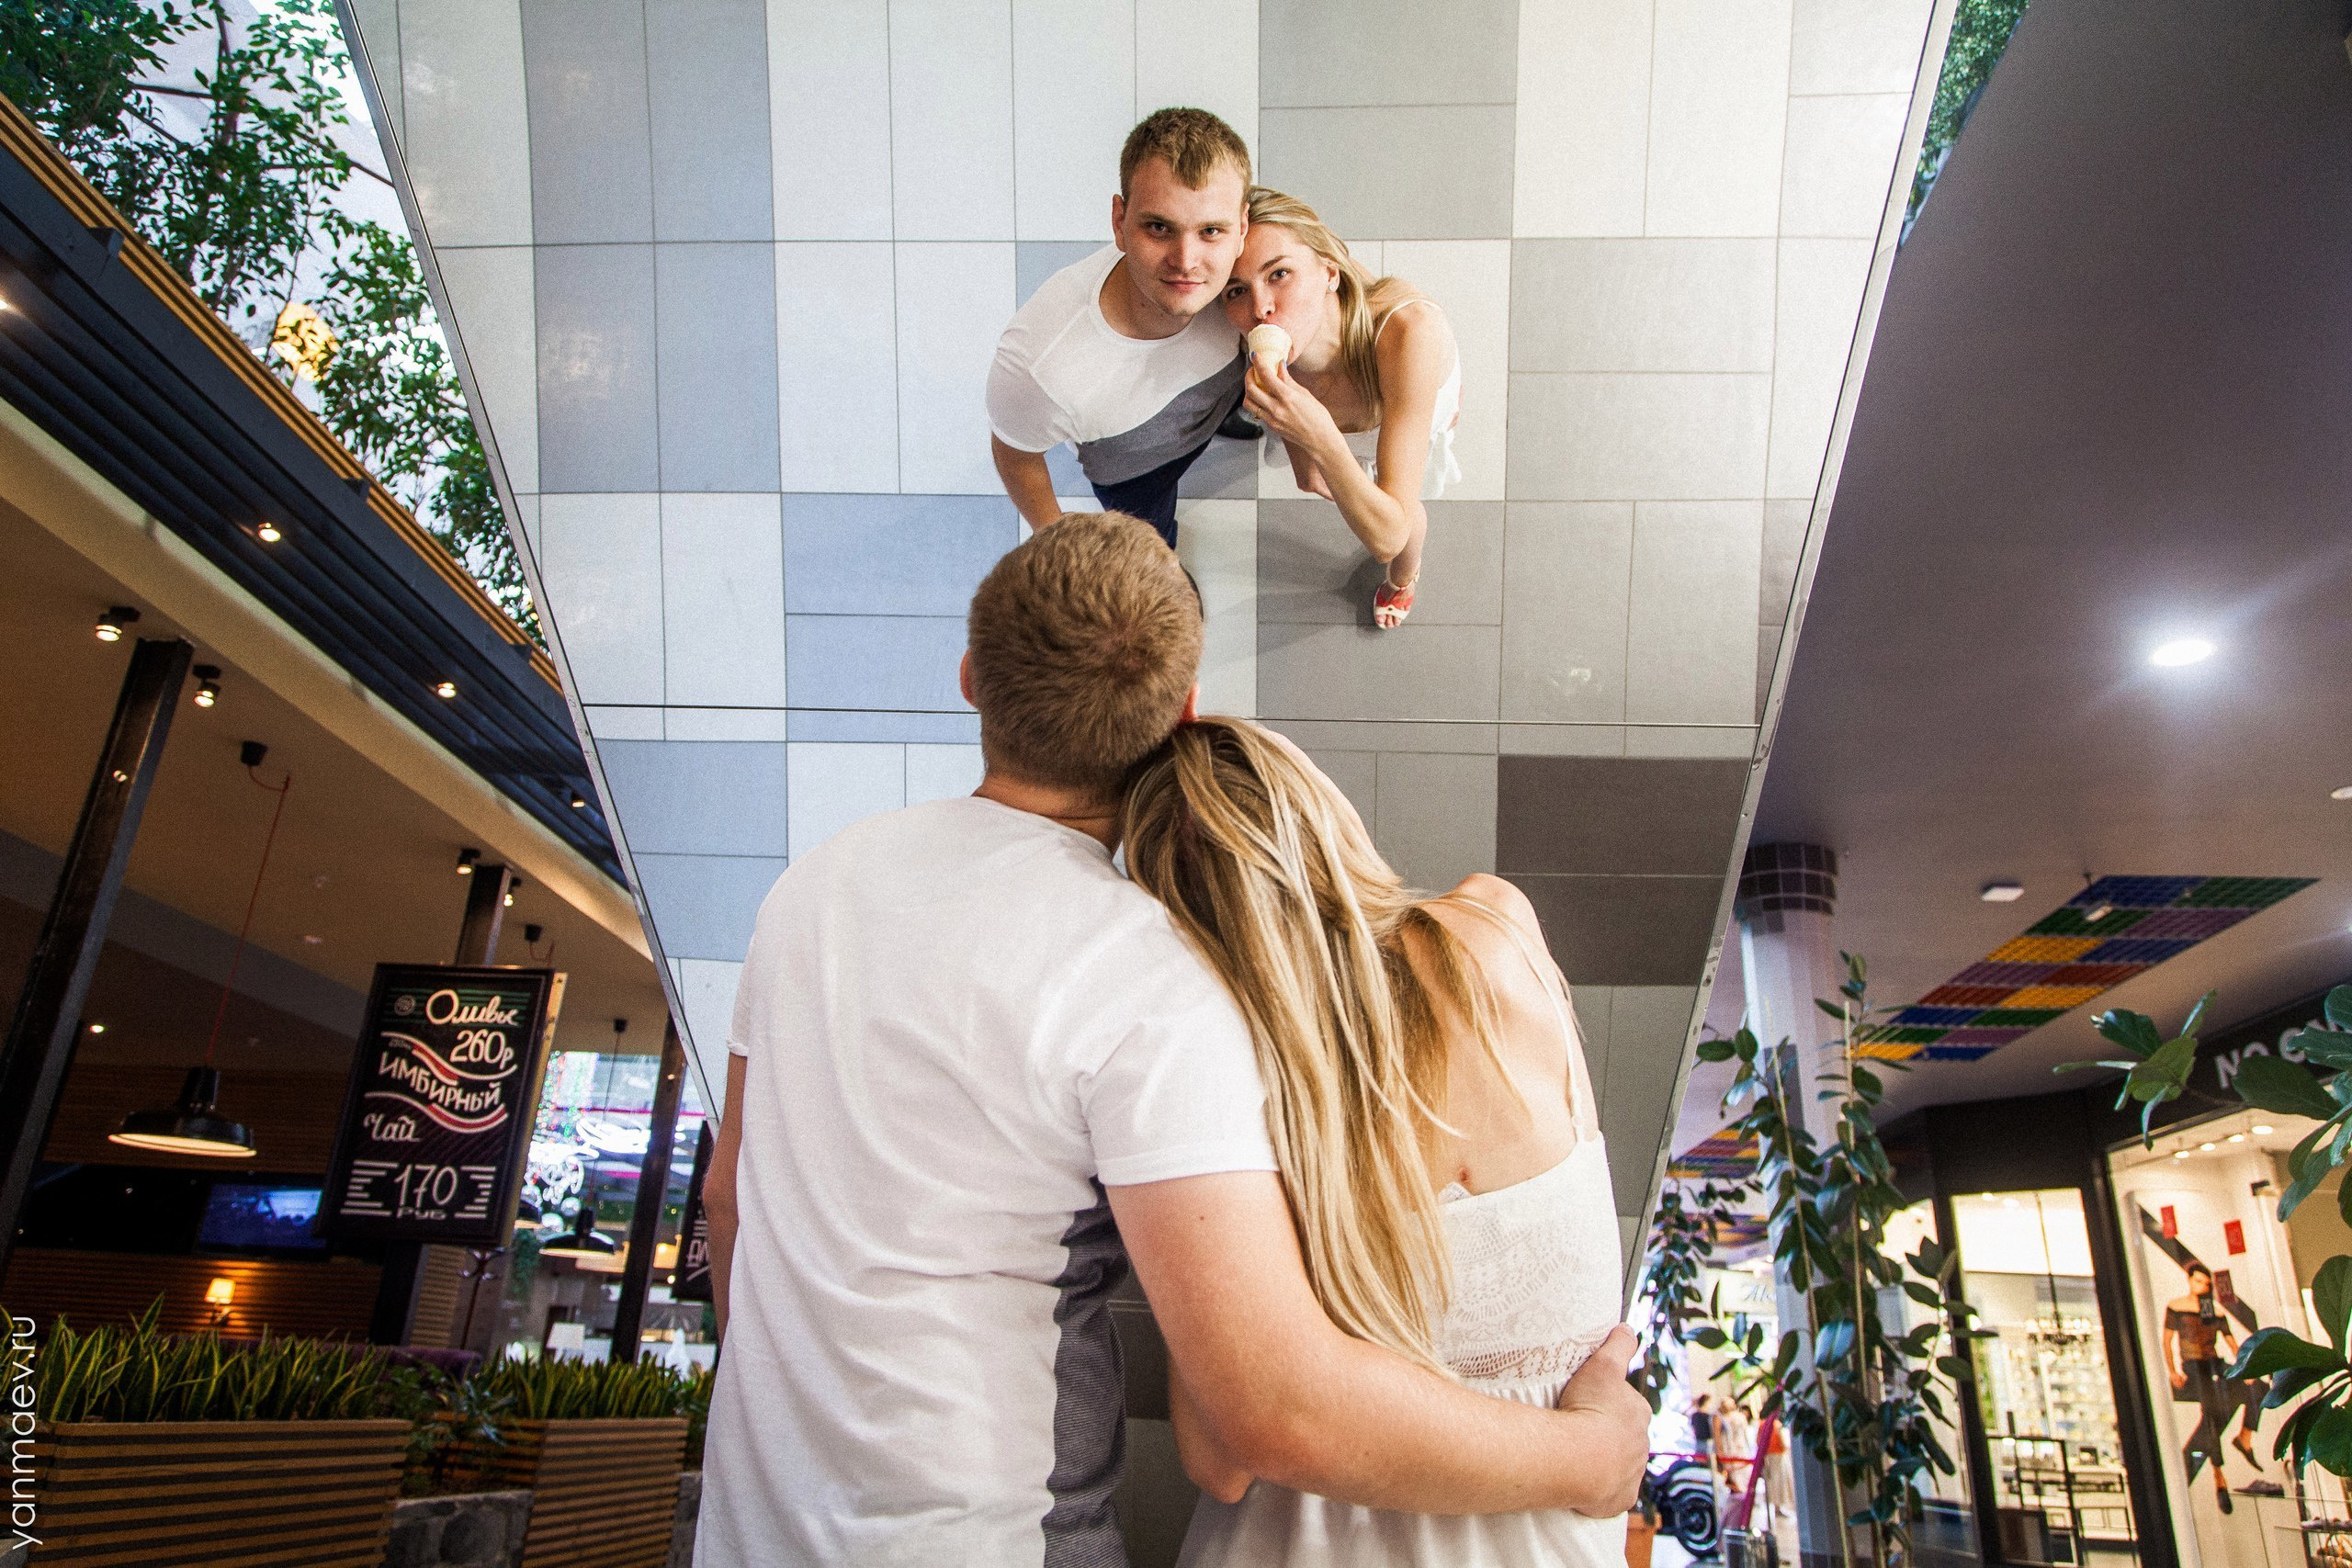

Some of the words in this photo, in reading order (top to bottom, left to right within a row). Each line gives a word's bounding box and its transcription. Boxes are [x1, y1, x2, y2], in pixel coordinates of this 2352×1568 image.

[378, 1050, 503, 1112] ИМБИРНЫЙ
[363, 1111, 421, 1143] Чай
[393, 1163, 458, 1206] 170
